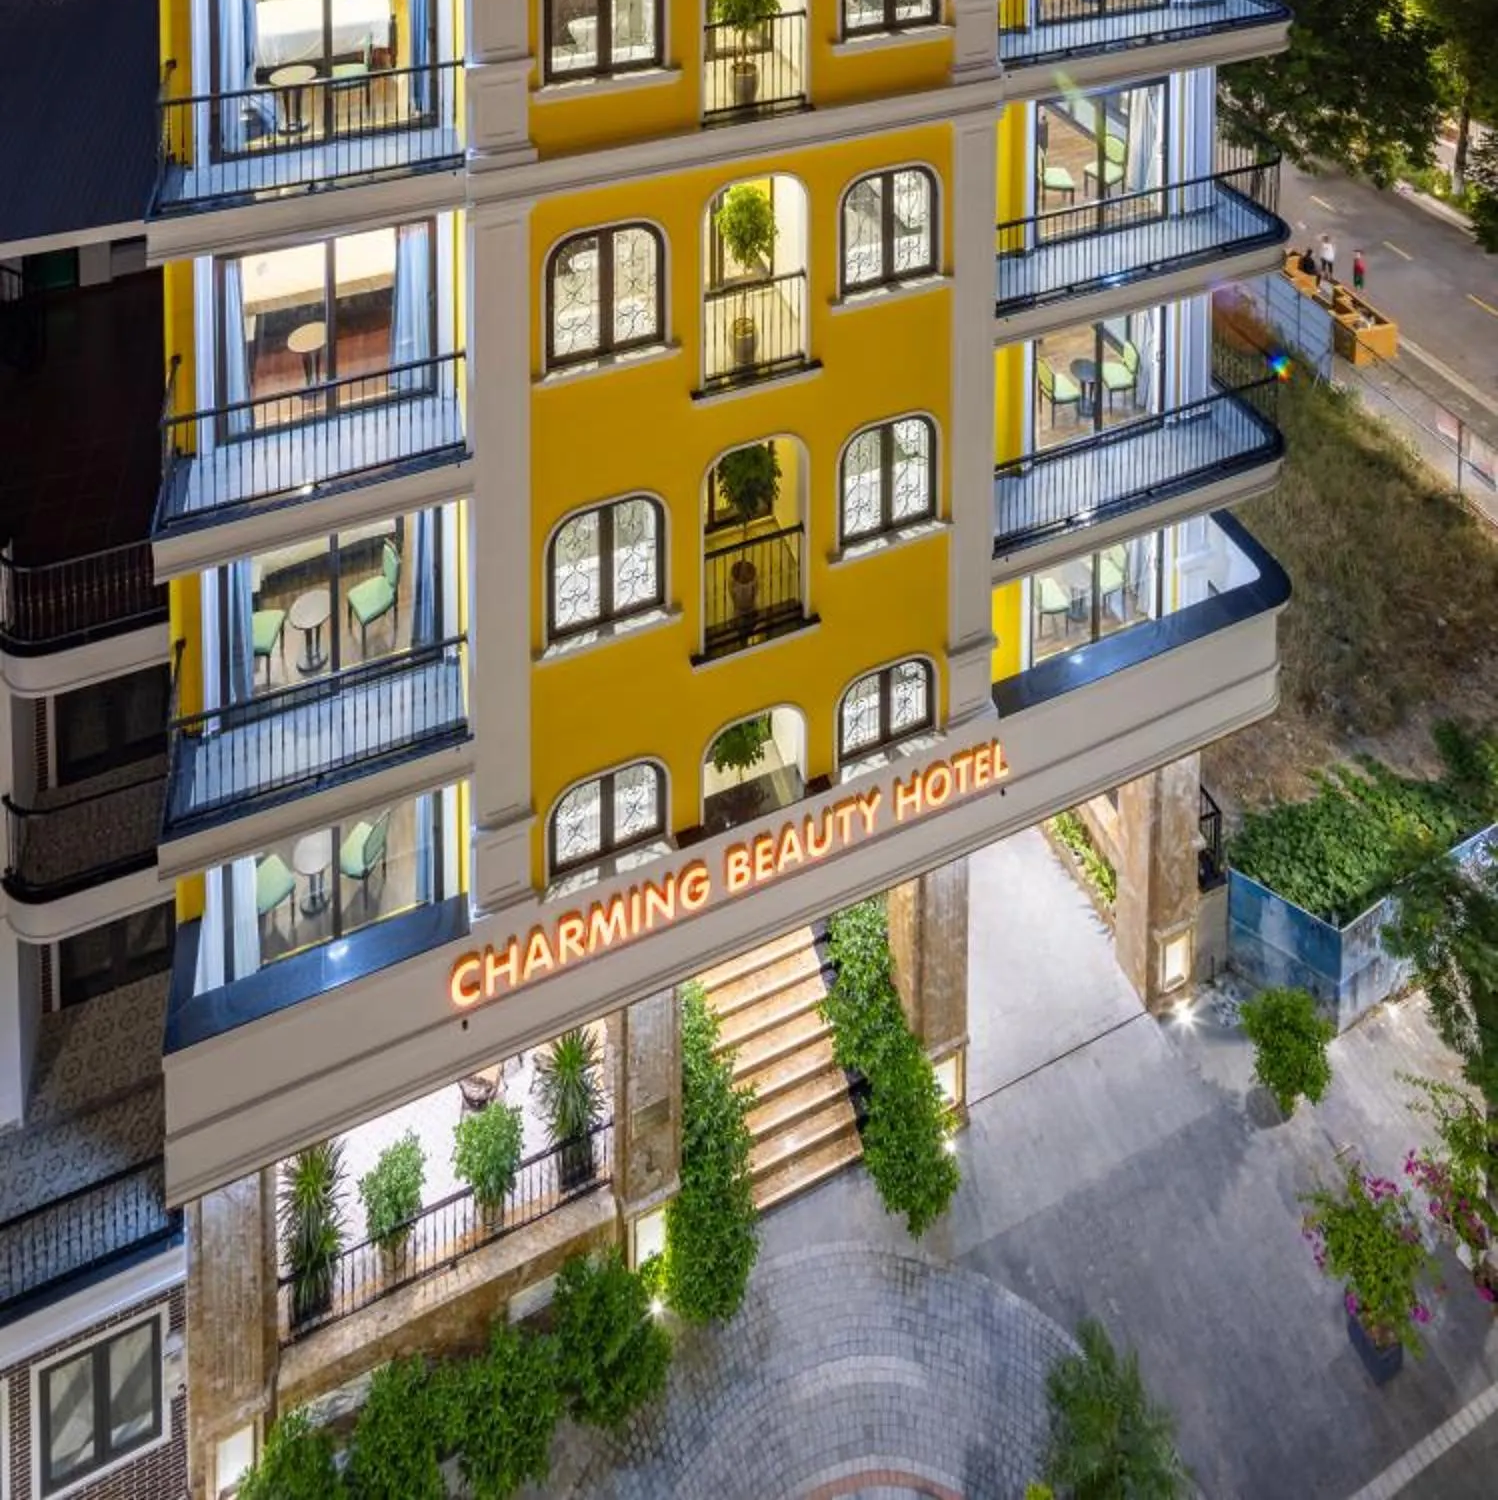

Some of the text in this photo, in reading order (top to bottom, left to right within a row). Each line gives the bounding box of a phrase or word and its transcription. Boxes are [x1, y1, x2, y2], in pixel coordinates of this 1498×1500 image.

[448, 741, 1009, 1008] CHARMING BEAUTY HOTEL
